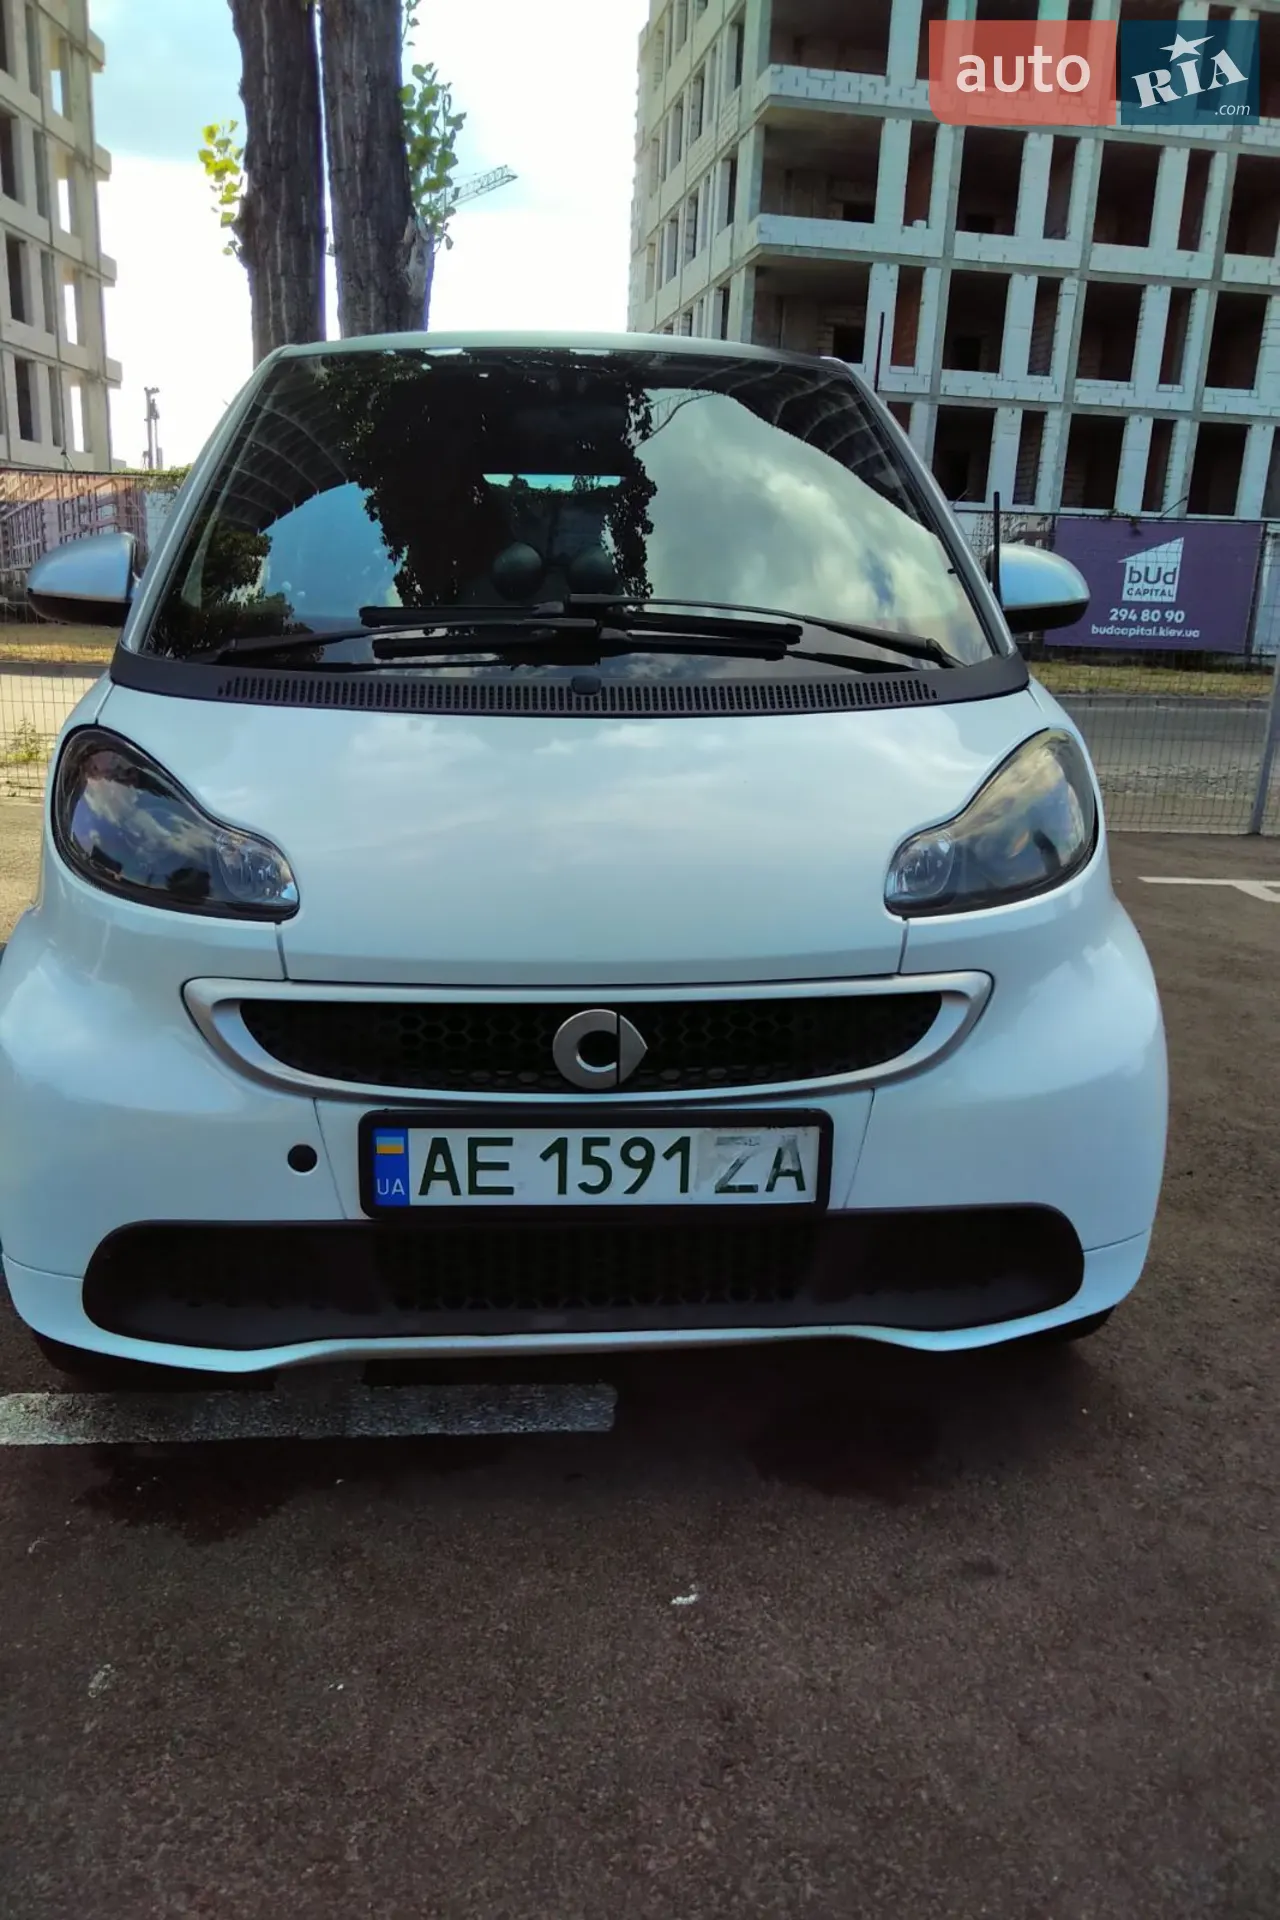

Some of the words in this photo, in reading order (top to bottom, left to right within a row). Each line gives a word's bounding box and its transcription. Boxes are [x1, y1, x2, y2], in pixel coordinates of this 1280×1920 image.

[1126, 587, 1174, 597] CAPITAL
[1109, 608, 1138, 622] 294
[1140, 608, 1161, 623] 80
[1164, 609, 1185, 624] 90
[1091, 624, 1200, 638] budcapital.kiev.ua
[418, 1137, 515, 1195] AE
[539, 1136, 691, 1195] 1591
[714, 1135, 806, 1194] ZA
[376, 1178, 405, 1196] UA
